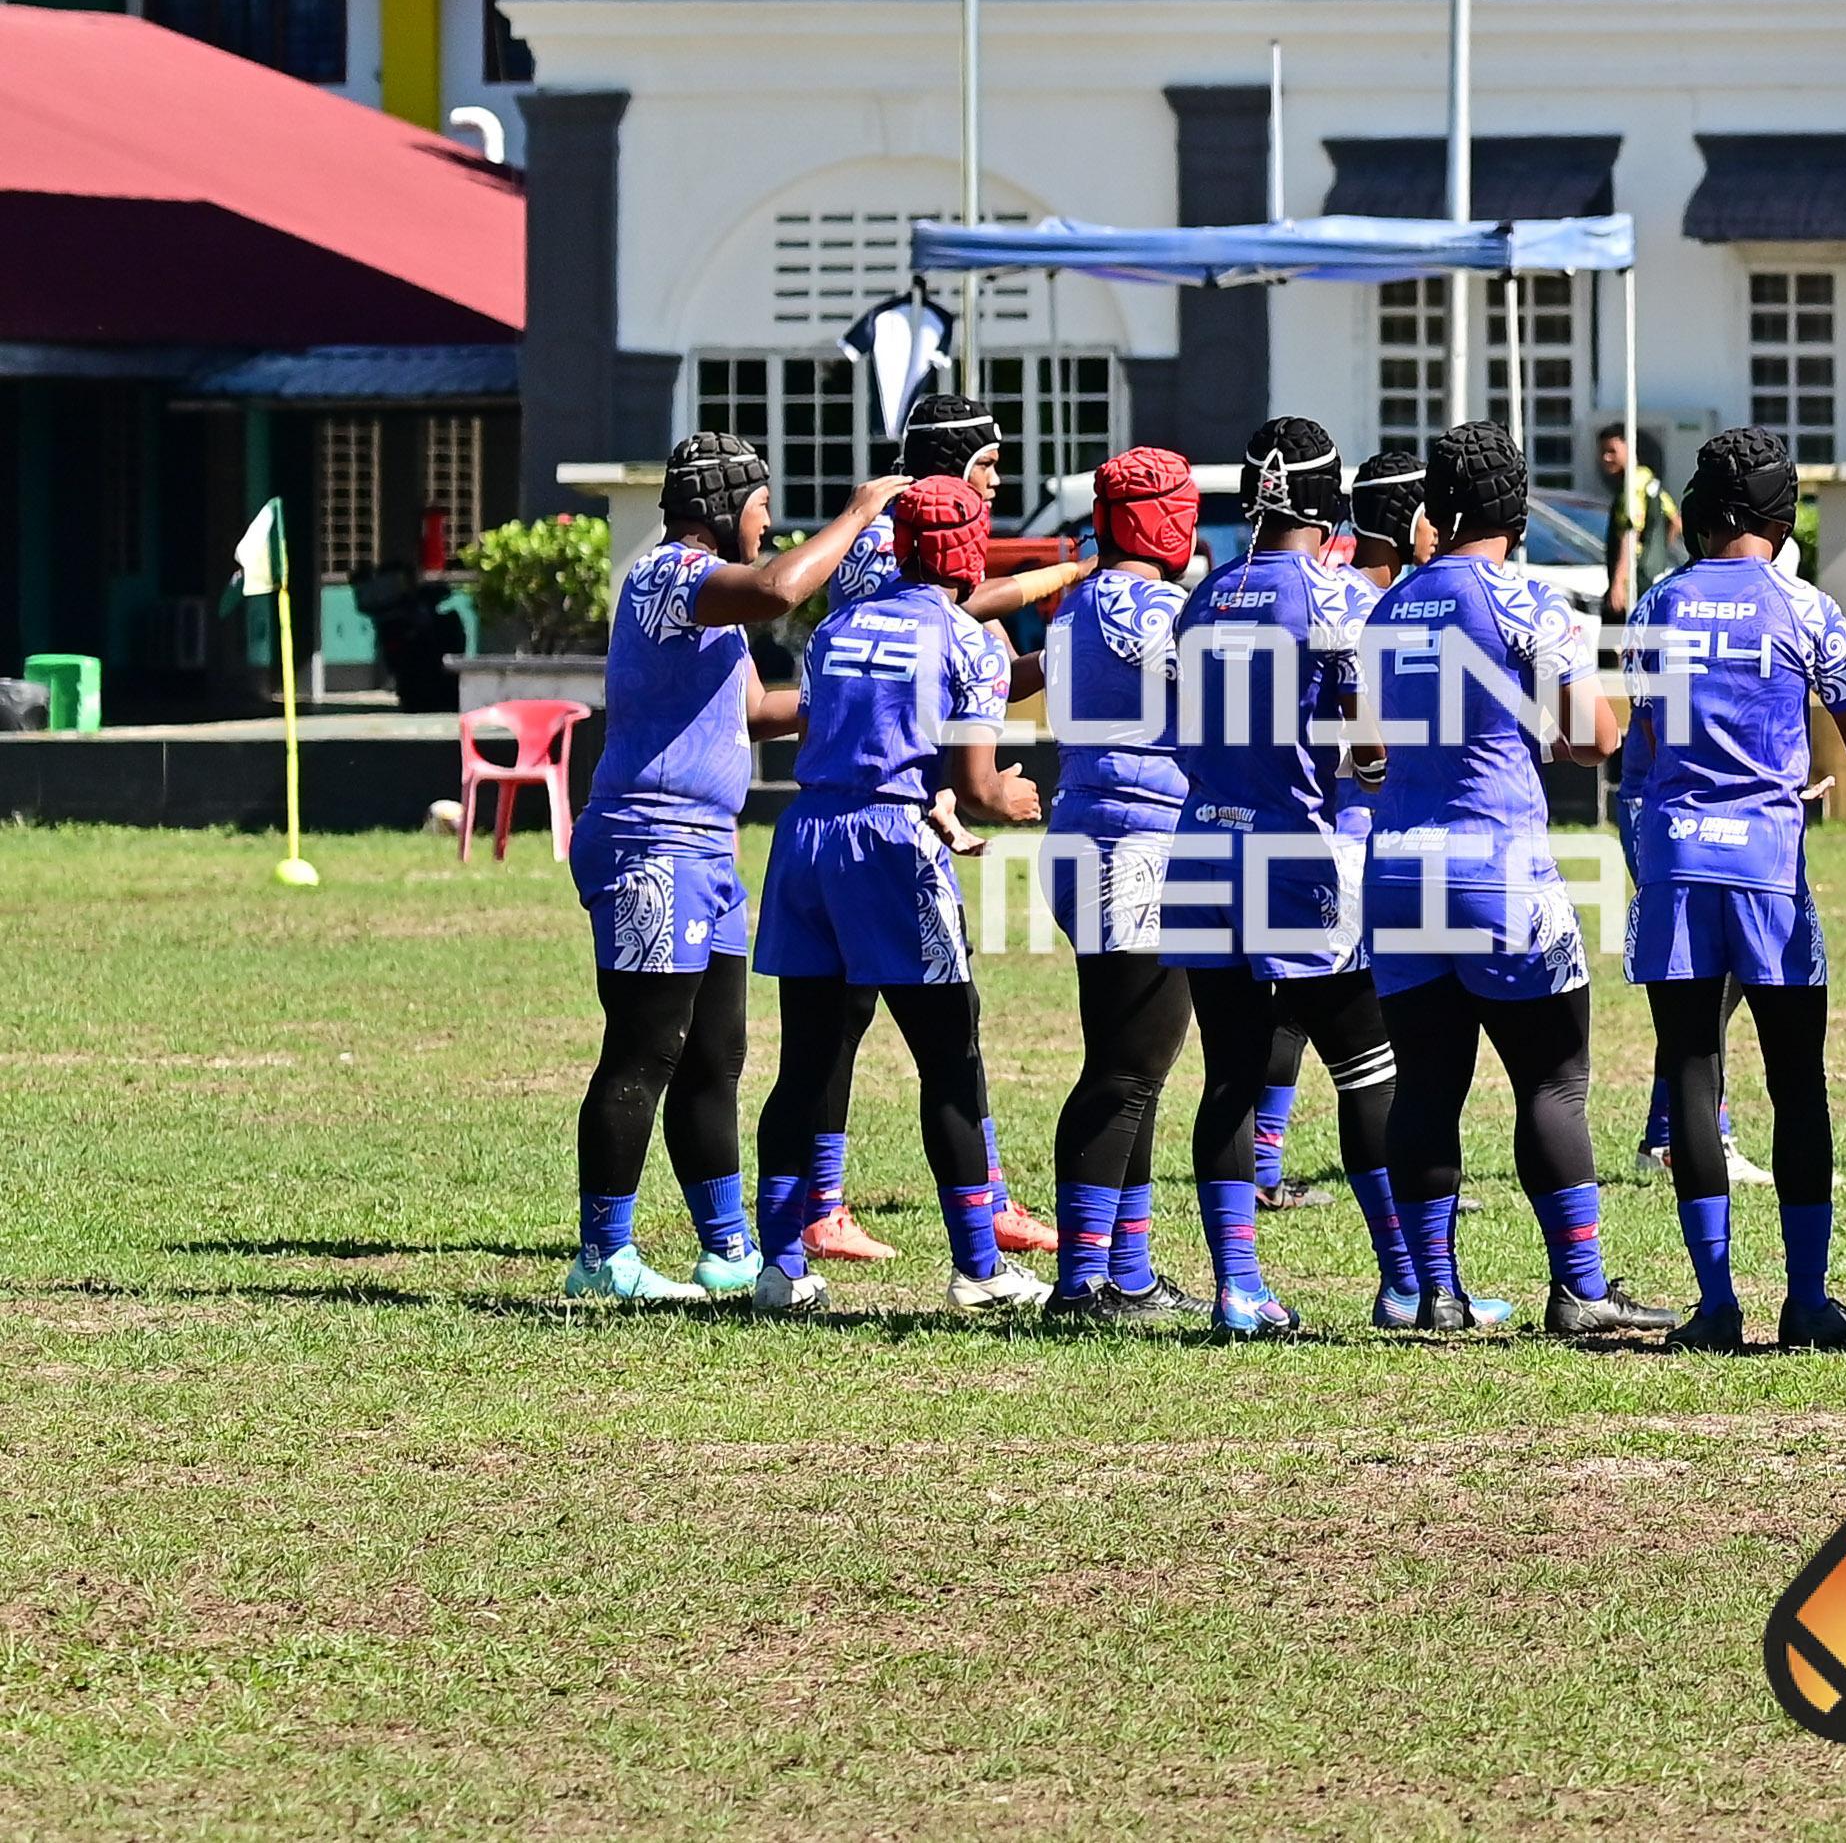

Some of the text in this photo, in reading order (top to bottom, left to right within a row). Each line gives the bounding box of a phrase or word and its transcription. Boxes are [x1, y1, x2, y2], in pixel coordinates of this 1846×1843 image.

[1209, 591, 1277, 608] HSBP
[1389, 599, 1456, 620] HSBP
[1676, 600, 1757, 620] HSBP
[850, 613, 920, 633] HSBP
[821, 636, 923, 683] 25
[1395, 629, 1442, 676] 2
[1659, 629, 1773, 679] 24
